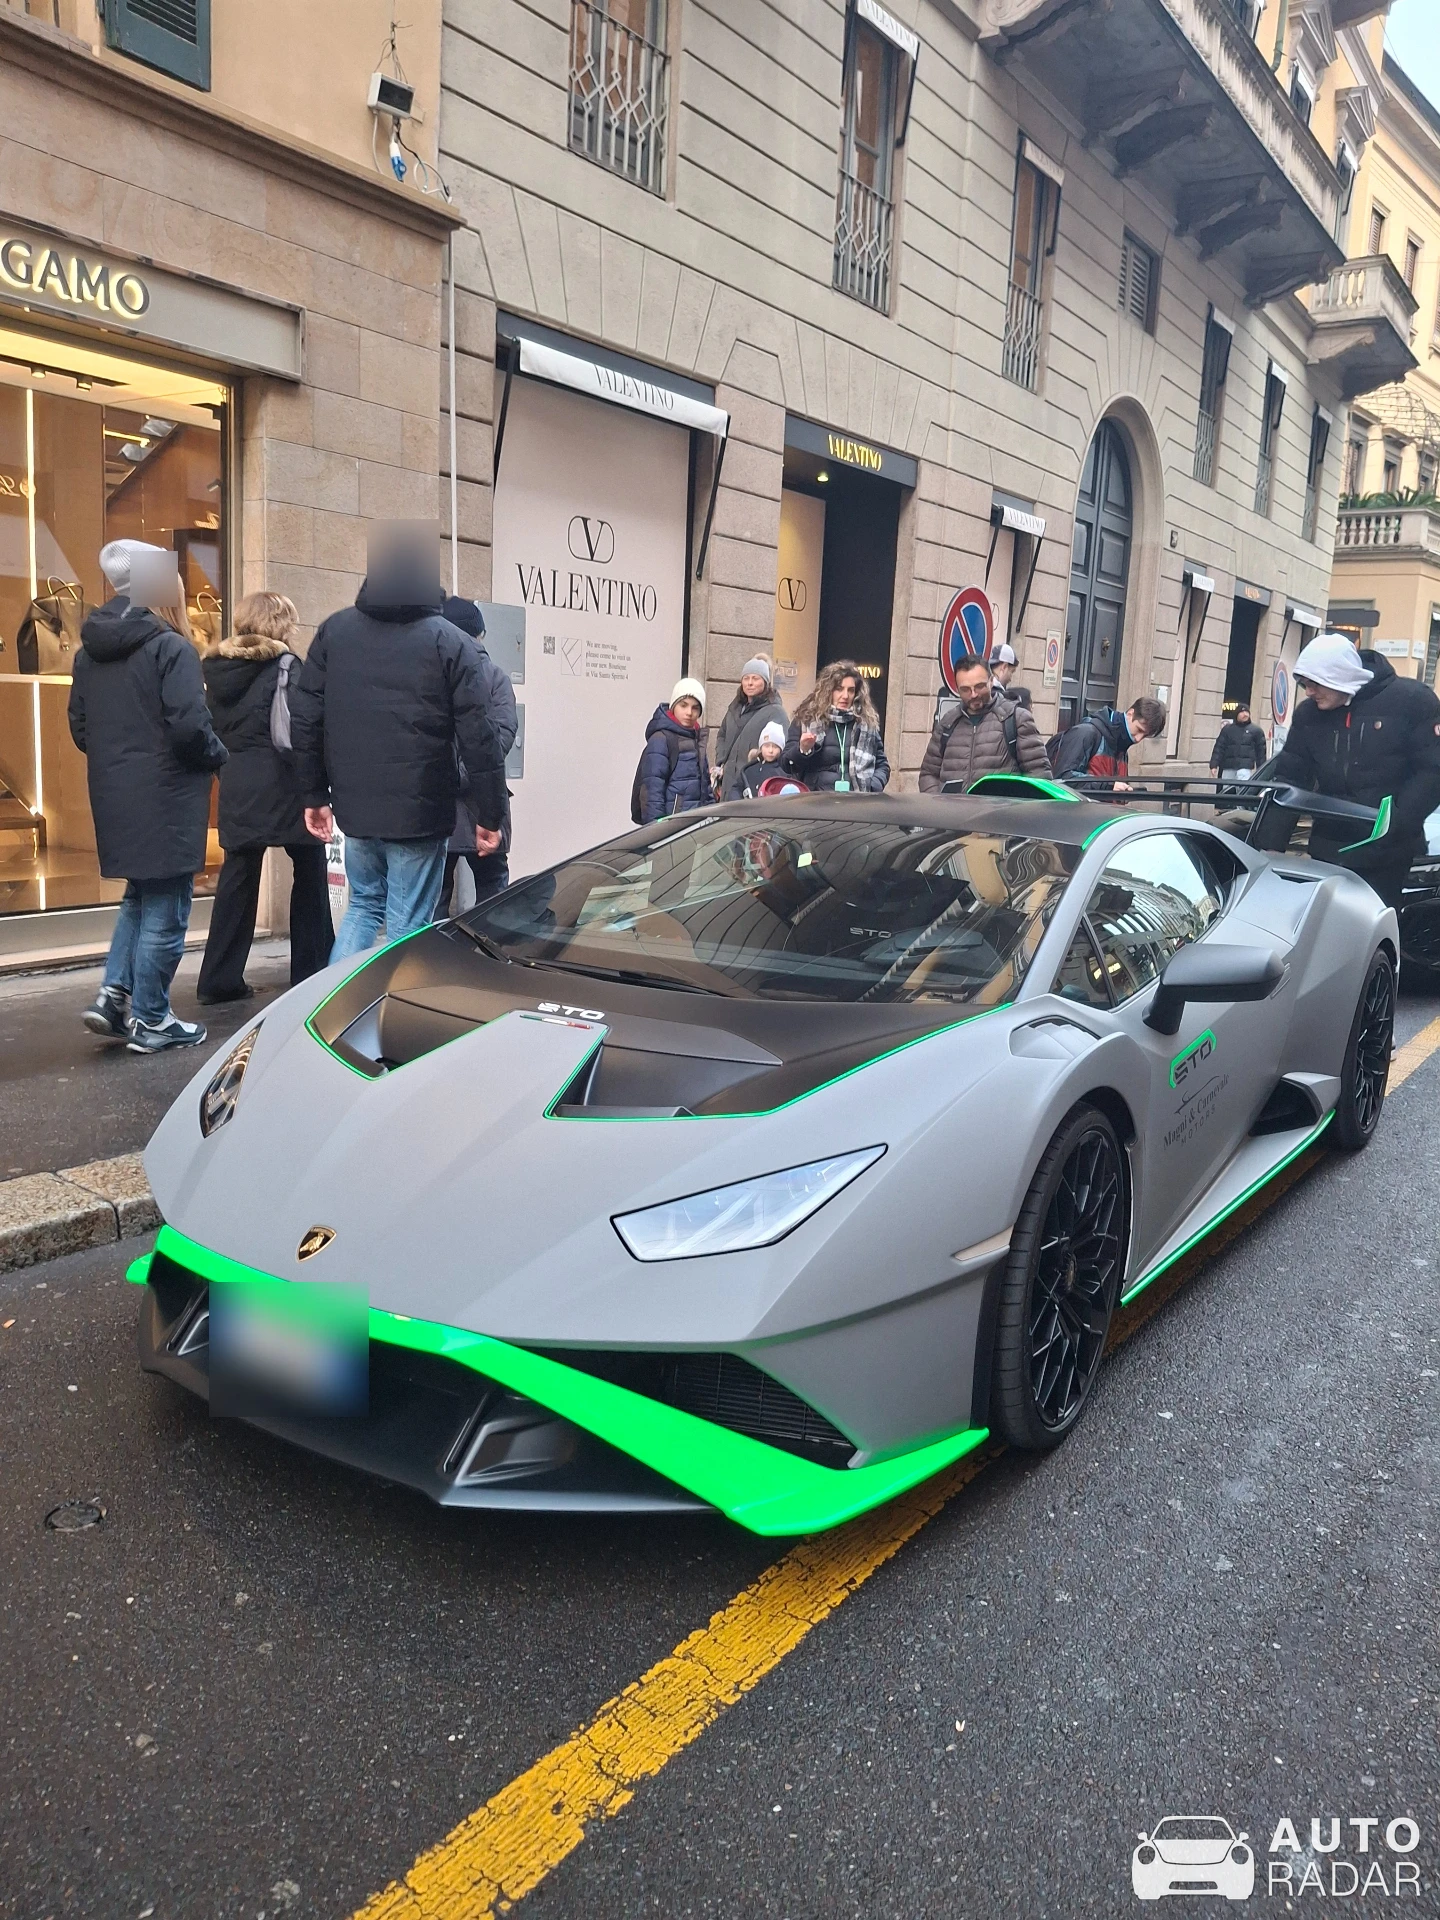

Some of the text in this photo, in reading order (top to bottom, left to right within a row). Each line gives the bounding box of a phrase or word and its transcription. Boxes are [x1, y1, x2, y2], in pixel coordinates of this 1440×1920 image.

[0, 239, 150, 317] GAMO
[593, 363, 674, 411] VALENTINO
[828, 434, 882, 471] VALENTINO
[515, 563, 657, 622] VALENTINO
[586, 651, 599, 659] please
[857, 666, 881, 679] TINO
[850, 926, 892, 938] STO
[537, 1002, 606, 1020] STO
[1174, 1039, 1212, 1085] STO
[1163, 1073, 1230, 1151] Magni & Carnevale
[1181, 1103, 1216, 1147] MOTORS
